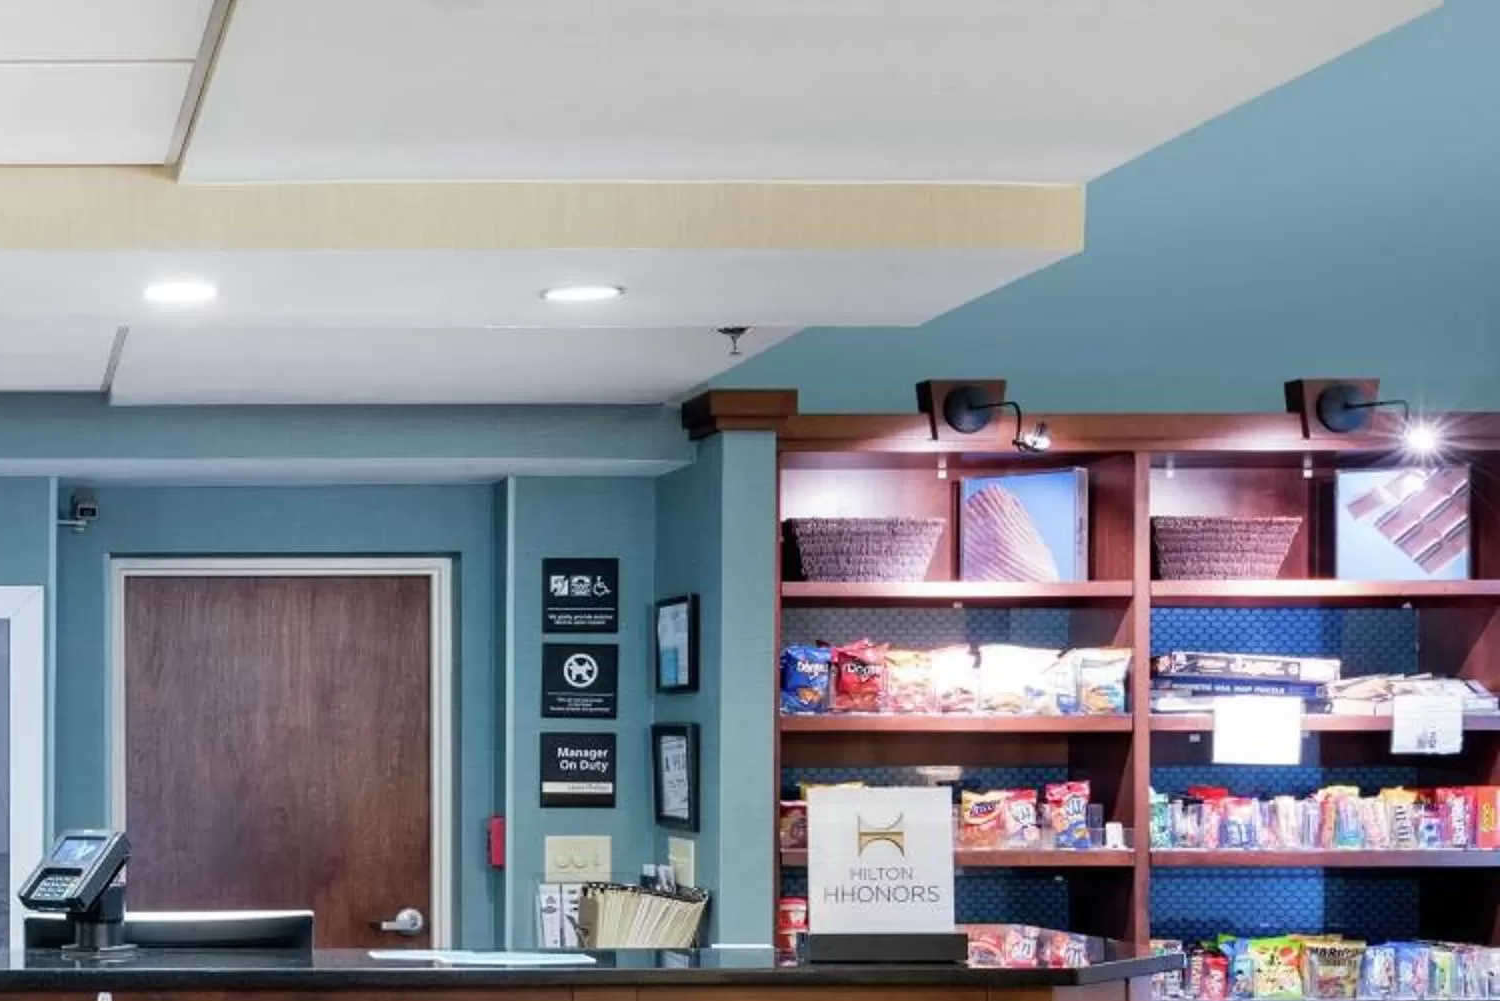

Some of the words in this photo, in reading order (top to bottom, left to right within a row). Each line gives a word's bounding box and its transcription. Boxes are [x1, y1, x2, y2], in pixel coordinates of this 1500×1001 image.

[557, 747, 609, 760] Manager
[559, 760, 577, 771] On
[579, 760, 609, 773] Duty
[849, 867, 914, 881] HILTON
[823, 885, 941, 904] HHONORS
